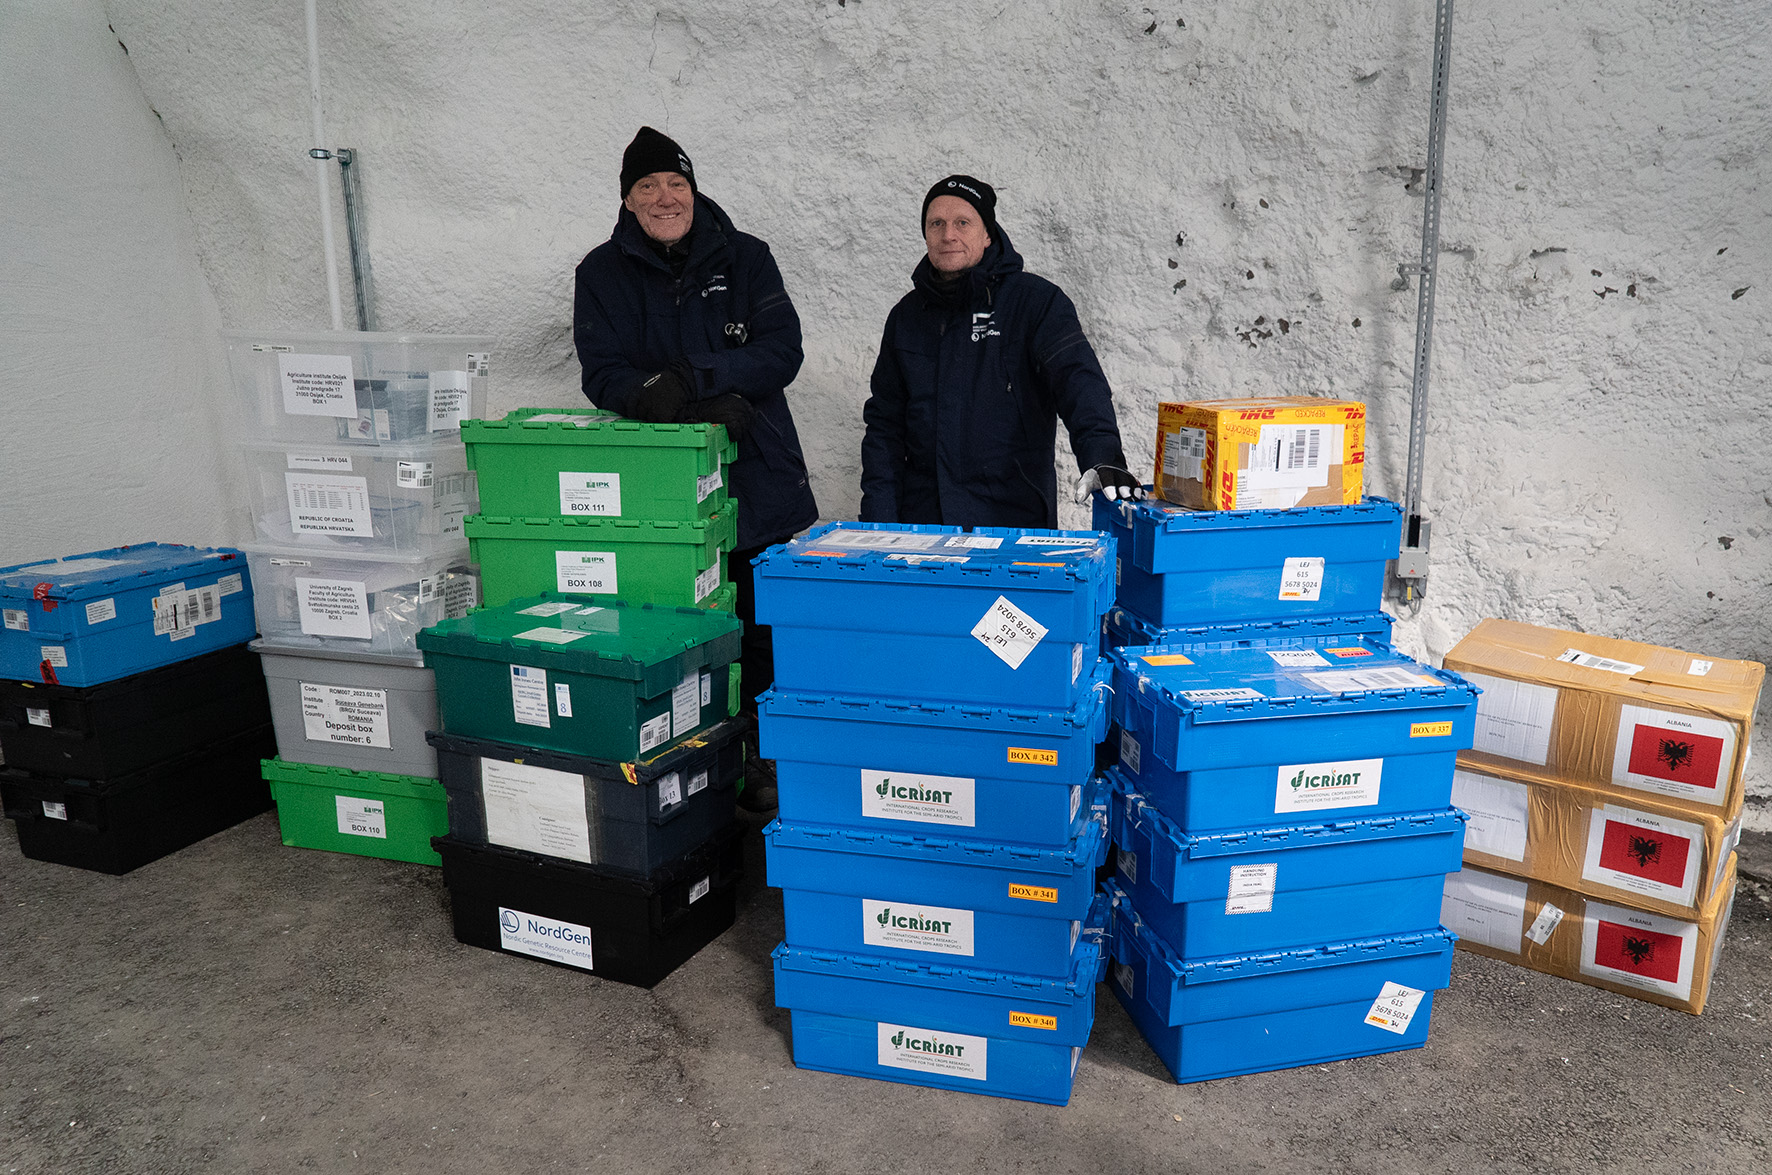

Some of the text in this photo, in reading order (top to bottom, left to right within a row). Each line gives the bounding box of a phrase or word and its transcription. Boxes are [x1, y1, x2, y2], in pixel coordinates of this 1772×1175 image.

[958, 183, 982, 200] NordGen
[1240, 408, 1326, 420] DHL REPACKED
[571, 503, 605, 512] BOX 111
[567, 579, 603, 588] BOX 108
[1284, 580, 1301, 588] 5678
[997, 604, 1037, 640] 5678 5024
[1000, 624, 1017, 639] 615
[303, 695, 324, 703] Institute
[702, 690, 708, 702] 8
[560, 702, 568, 714] 8
[304, 710, 373, 723] Country ROMANIA
[325, 720, 373, 733] Deposit box
[1666, 719, 1692, 728] ALBANIA
[1413, 726, 1430, 734] BOX
[1437, 725, 1450, 734] 337
[330, 734, 372, 744] number: 6
[1011, 751, 1031, 760] BOX
[1040, 753, 1054, 762] 342
[1305, 769, 1361, 788] ICRISAT
[891, 783, 952, 804] ICRISAT
[886, 803, 920, 811] INTERNATIONAL
[945, 813, 963, 821] TROPICS
[1635, 818, 1660, 827] ALBANIA
[351, 824, 381, 834] BOX 110
[1012, 887, 1031, 896] BOX
[1040, 890, 1054, 899] 341
[892, 913, 951, 934] ICRISAT
[1628, 917, 1652, 926] ALBANIA
[527, 919, 591, 946] NordGen
[887, 931, 920, 940] INTERNATIONAL
[503, 932, 592, 960] Nordic Genetic Resource Centre
[945, 942, 962, 950] TROPICS
[1391, 998, 1404, 1007] 615
[1375, 1005, 1409, 1020] 5678 5024
[1012, 1015, 1031, 1024] BOX
[1040, 1018, 1054, 1027] 340
[905, 1037, 964, 1057] ICRISAT
[900, 1053, 933, 1062] INTERNATIONAL
[958, 1064, 975, 1073] TROPICS
